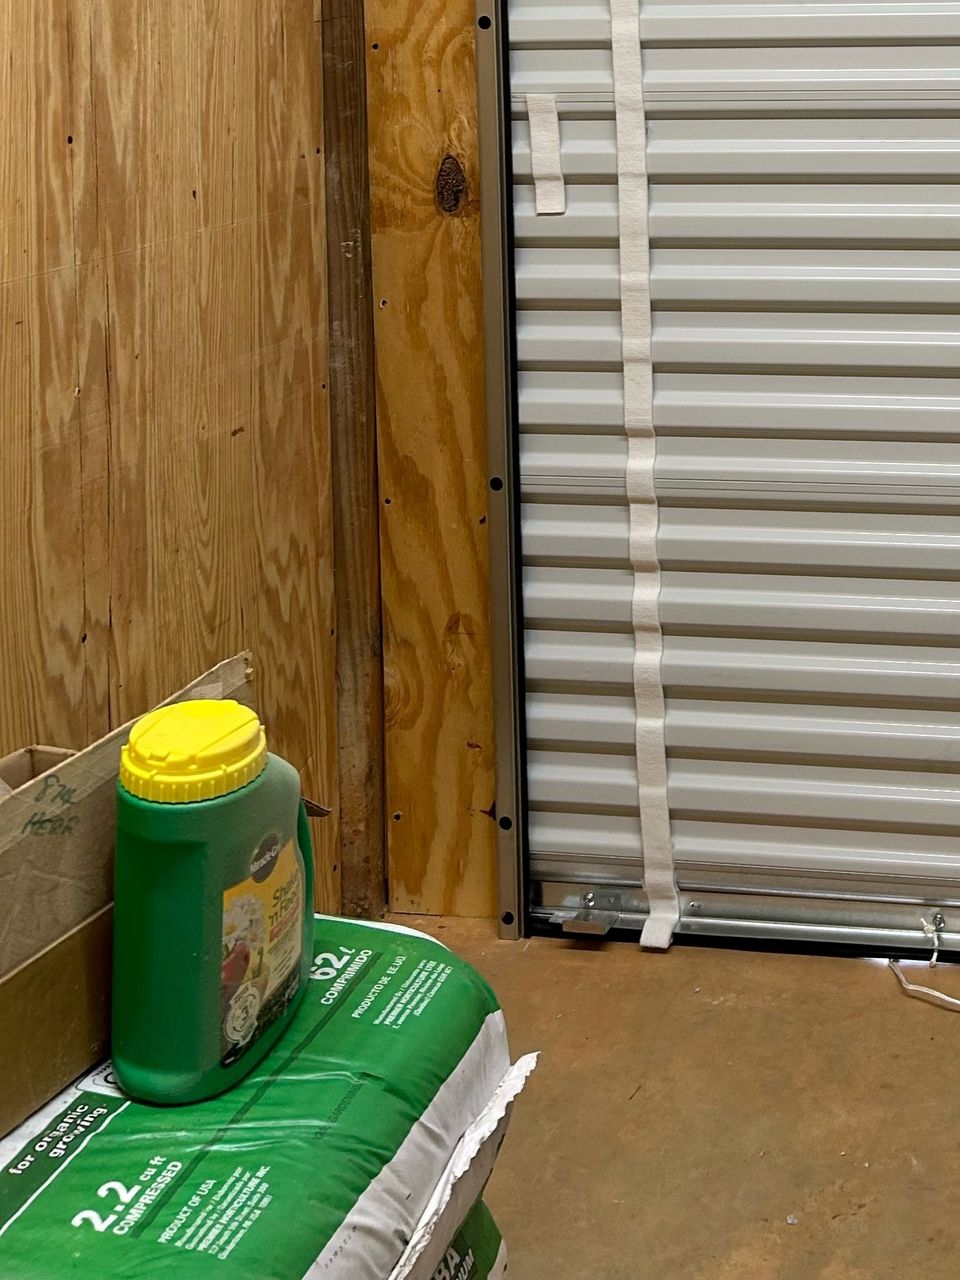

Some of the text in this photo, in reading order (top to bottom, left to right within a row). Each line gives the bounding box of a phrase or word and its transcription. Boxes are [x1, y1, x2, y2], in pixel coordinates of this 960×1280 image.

[310, 953, 351, 980] 62
[321, 949, 373, 1005] COMPRIMIDO
[352, 983, 384, 1018] PRODUCTO
[378, 975, 391, 985] DE
[9, 1104, 89, 1175] for organic
[49, 1107, 108, 1157] growing
[71, 1156, 167, 1232] 2.2 cu ft
[113, 1161, 182, 1235] COMPRESSED
[157, 1180, 217, 1244] PRODUCT OF USA
[219, 1177, 261, 1224] HORTICULTURE
